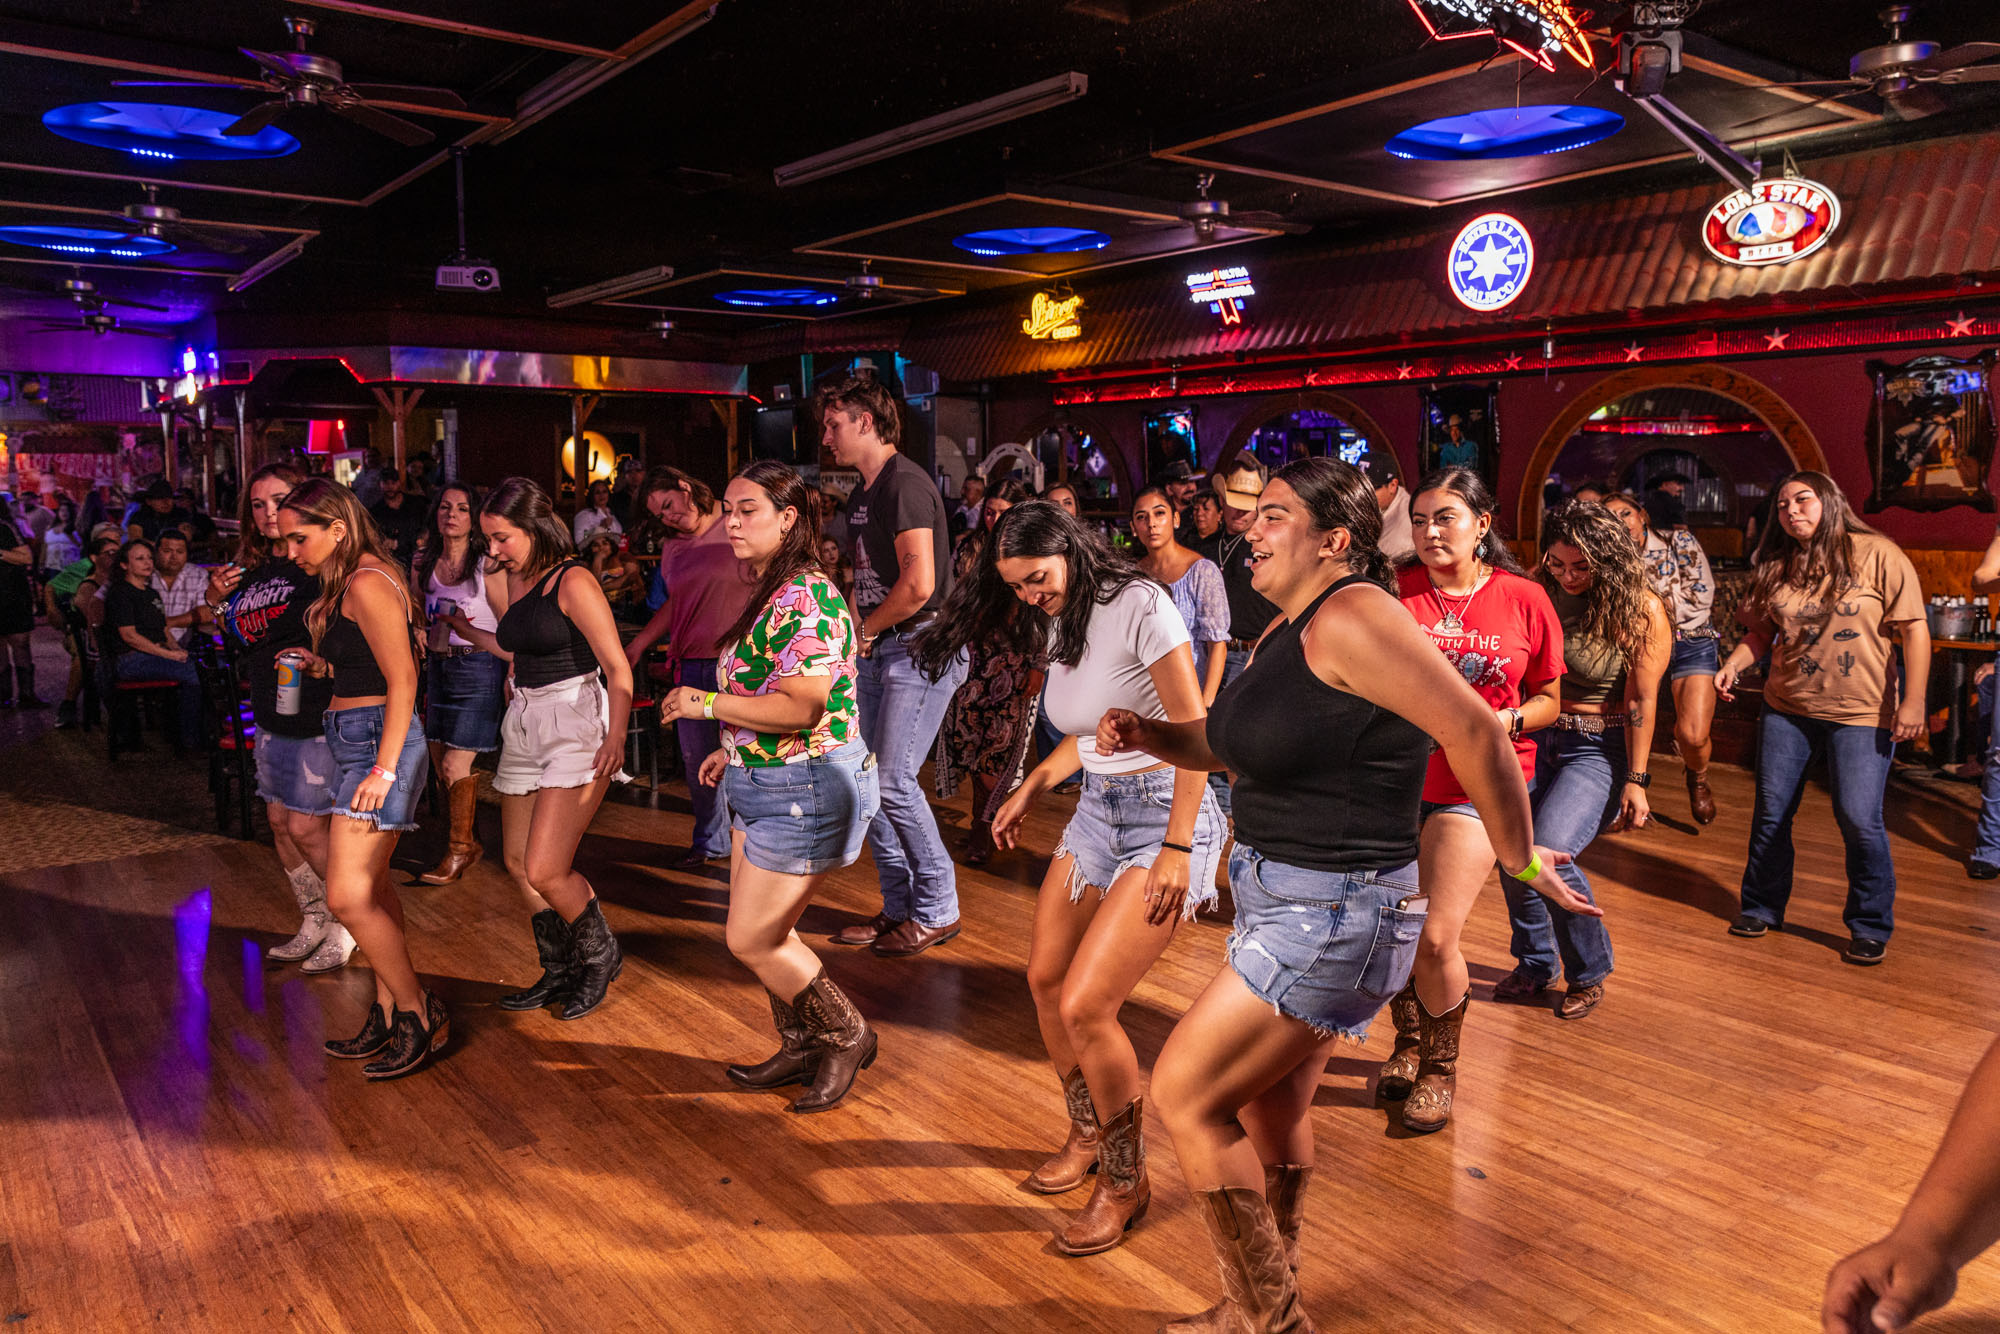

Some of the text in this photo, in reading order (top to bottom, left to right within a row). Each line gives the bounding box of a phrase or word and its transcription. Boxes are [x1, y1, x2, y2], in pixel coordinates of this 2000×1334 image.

[1713, 184, 1824, 224] LONE STAR
[1458, 220, 1522, 255] ESTRELLA
[1218, 266, 1249, 280] ULTRA
[1463, 281, 1515, 304] JALISCO
[1023, 292, 1081, 335] Shiner
[1430, 634, 1501, 651] WITH THE
